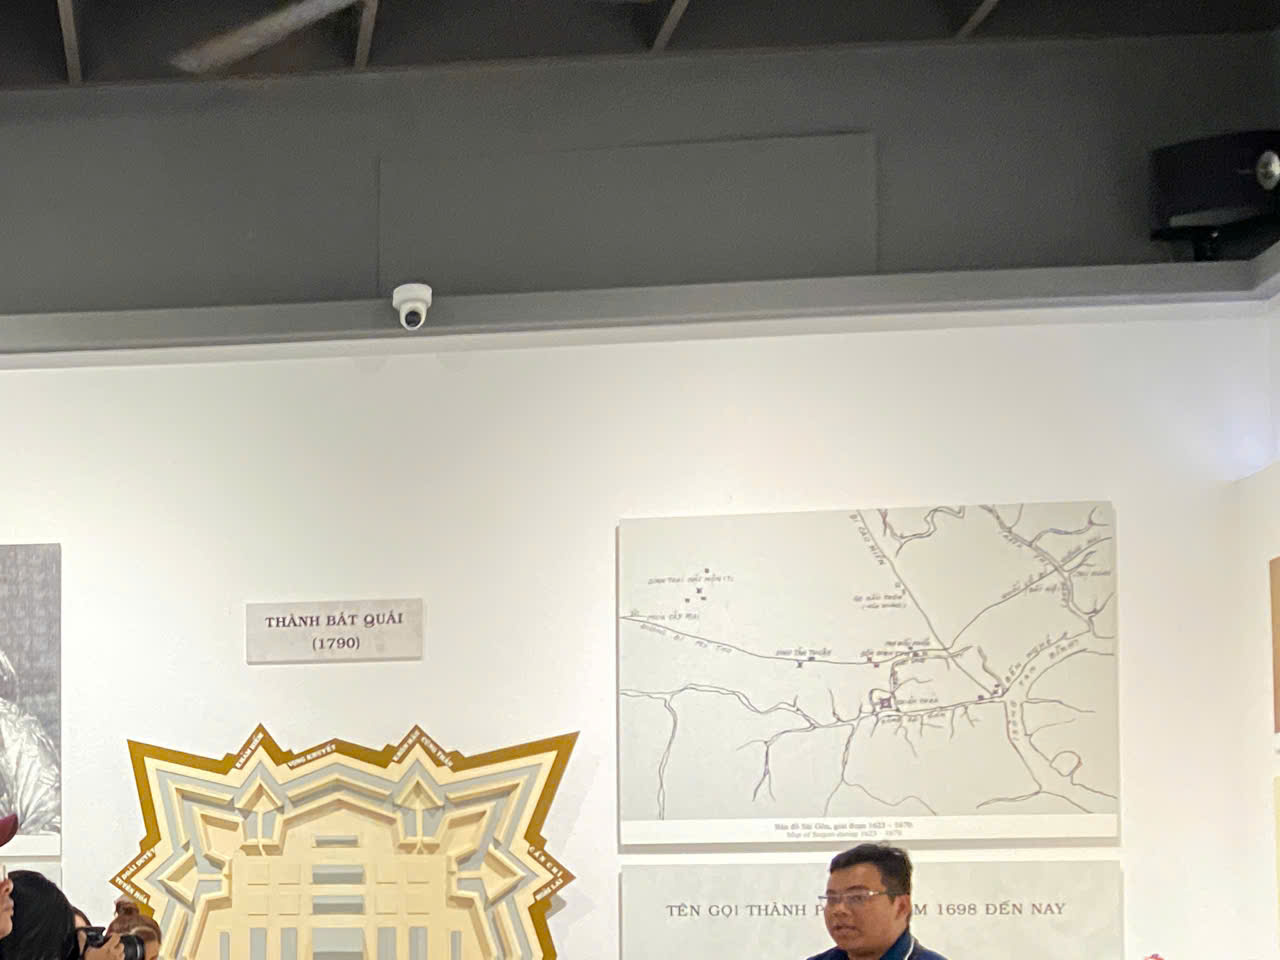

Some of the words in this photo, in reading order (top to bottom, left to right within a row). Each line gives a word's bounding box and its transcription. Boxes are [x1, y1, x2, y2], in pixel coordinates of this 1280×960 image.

[265, 613, 320, 628] THÀNH
[326, 611, 359, 626] BÁT
[364, 610, 404, 628] QUÁI
[312, 637, 361, 651] (1790)
[666, 903, 701, 917] TÊN
[708, 904, 739, 918] GỌI
[746, 902, 807, 917] THÀNH
[937, 903, 977, 916] 1698
[985, 900, 1023, 916] ĐẾN
[1031, 902, 1066, 915] NAY
